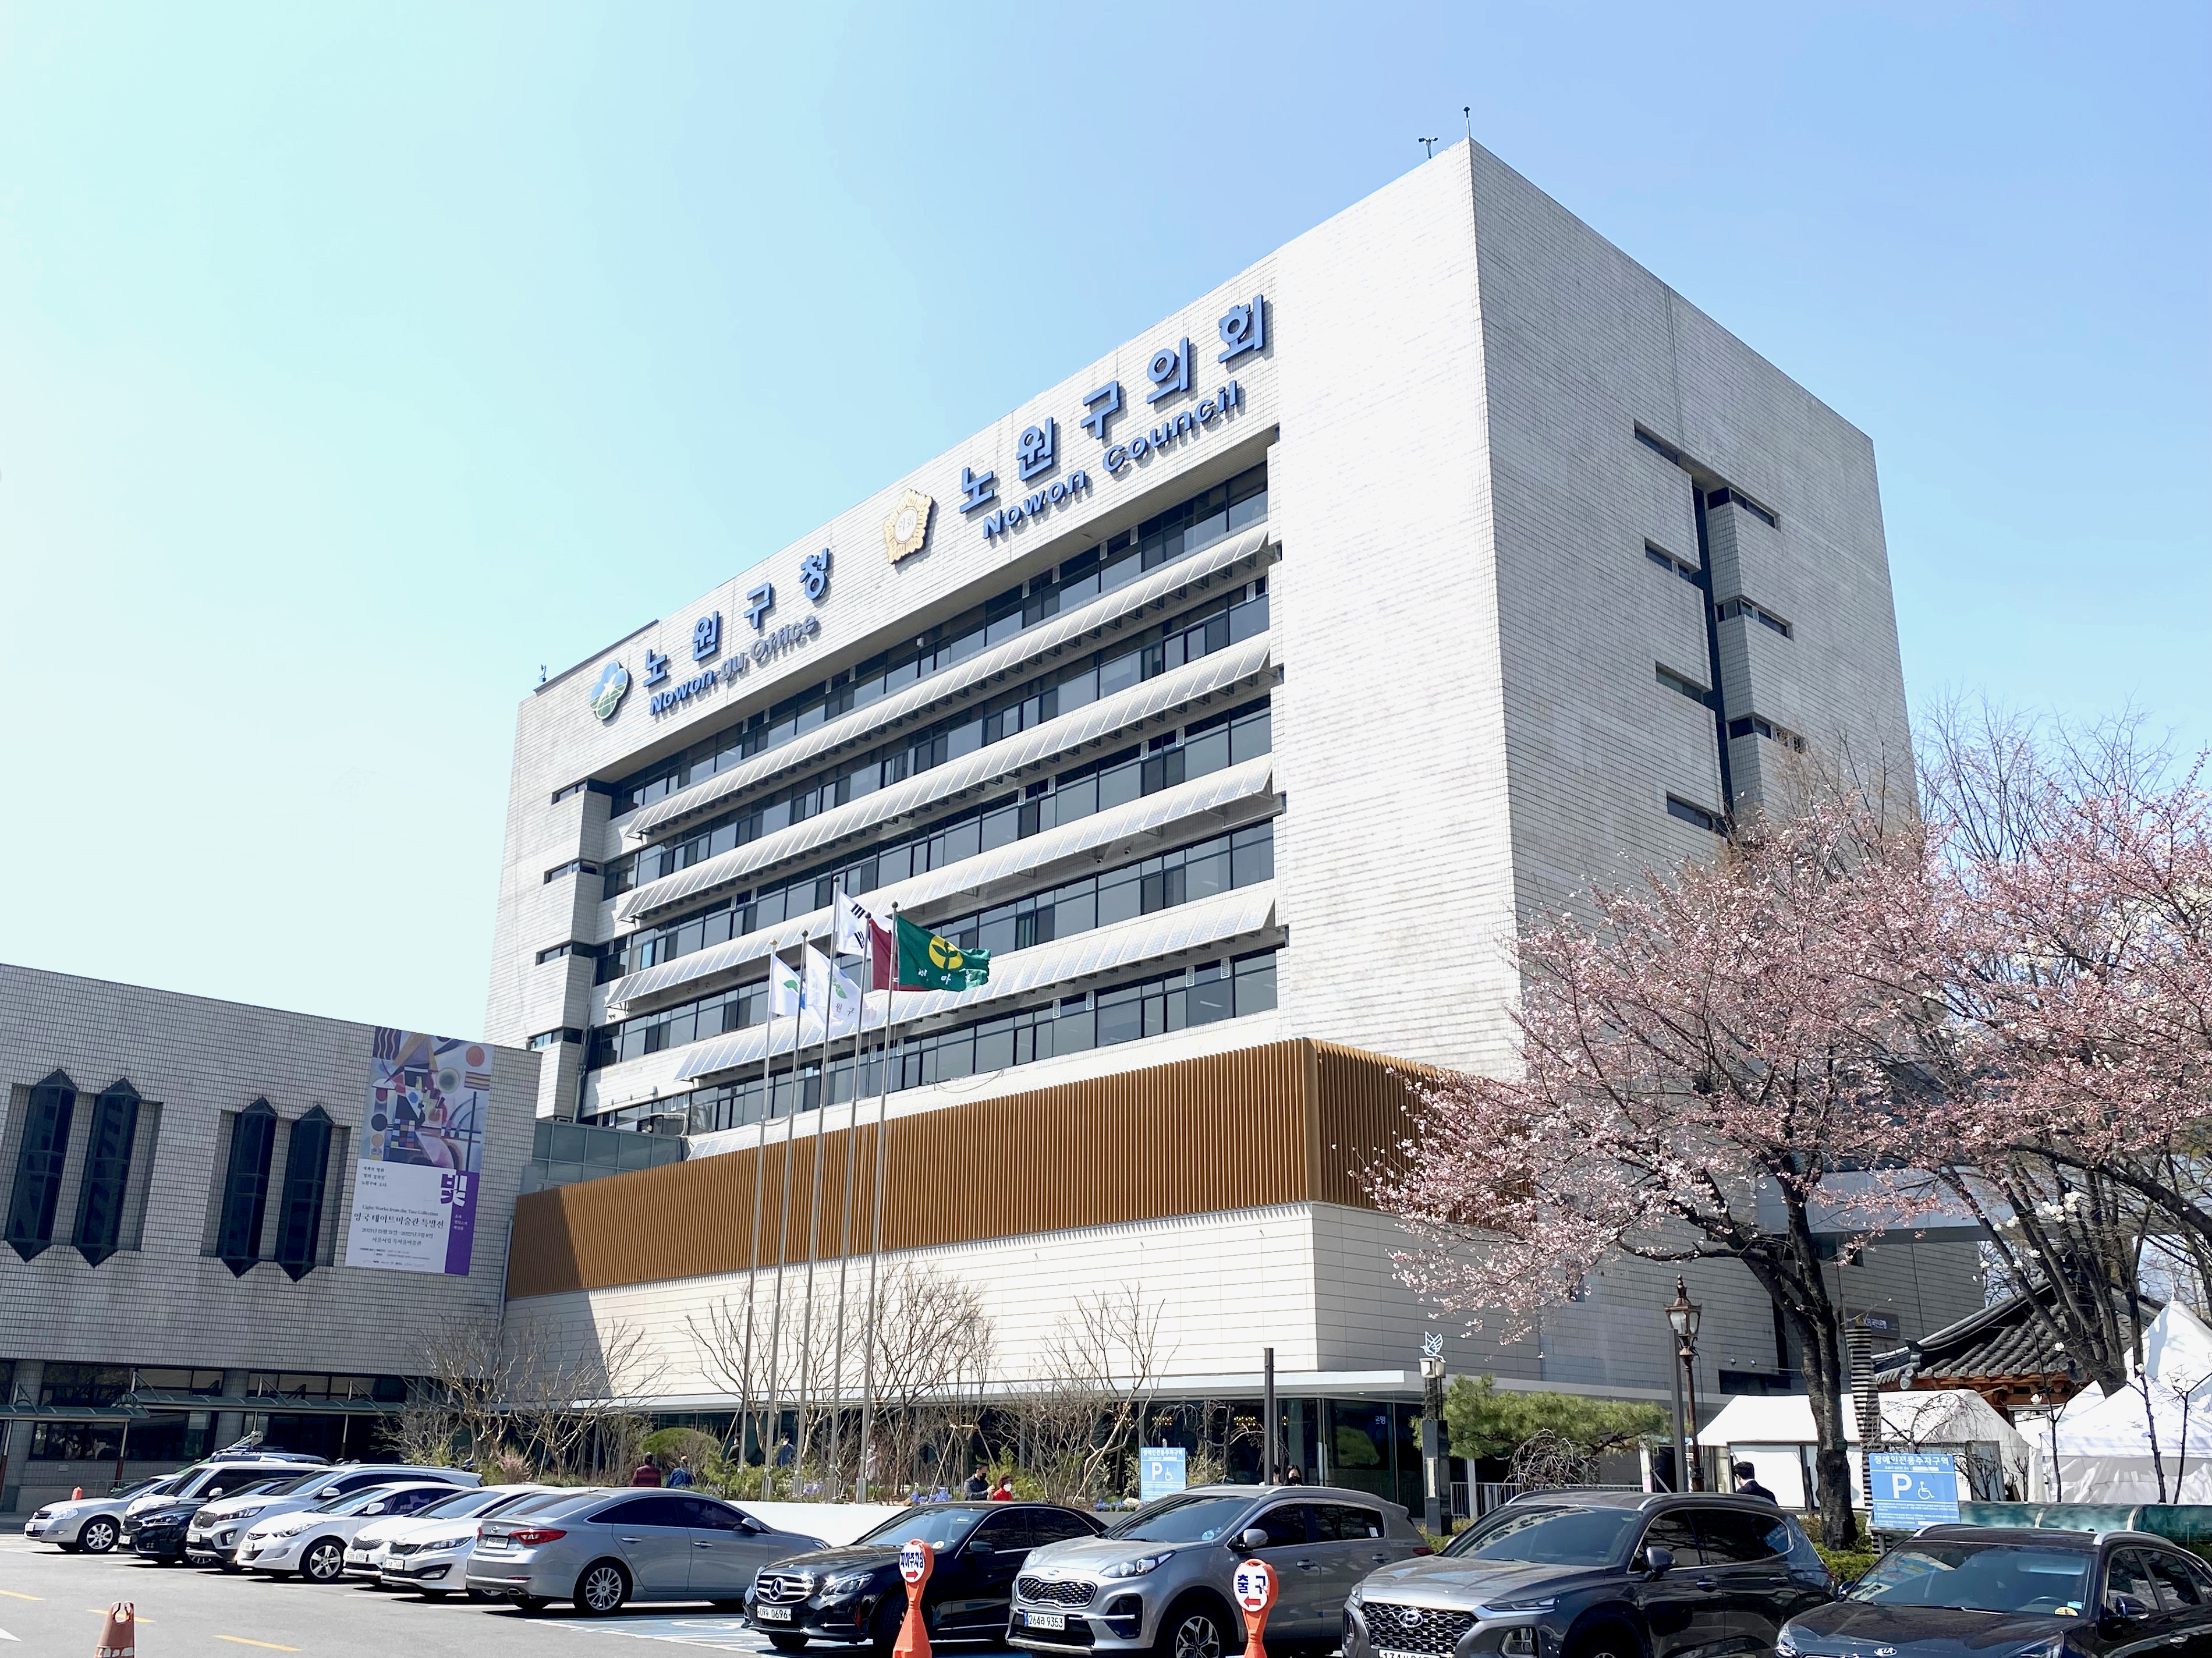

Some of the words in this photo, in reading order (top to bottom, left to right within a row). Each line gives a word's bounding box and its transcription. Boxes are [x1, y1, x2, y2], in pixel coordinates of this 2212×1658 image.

[959, 293, 1264, 514] 노원구의회
[983, 470, 1086, 539] Nowon
[1103, 380, 1238, 472] Council
[898, 513, 914, 532] 의회
[643, 548, 829, 687] 노원구청
[650, 651, 746, 715] Nowon-gu
[750, 615, 817, 661] Office
[1874, 1455, 1949, 1466] 장애인전용주차구역
[1151, 1462, 1163, 1481] P
[1892, 1473, 1912, 1499] P
[1237, 1574, 1266, 1595] 출구
[771, 1609, 788, 1619] 0696
[1047, 1616, 1063, 1628] 9353
